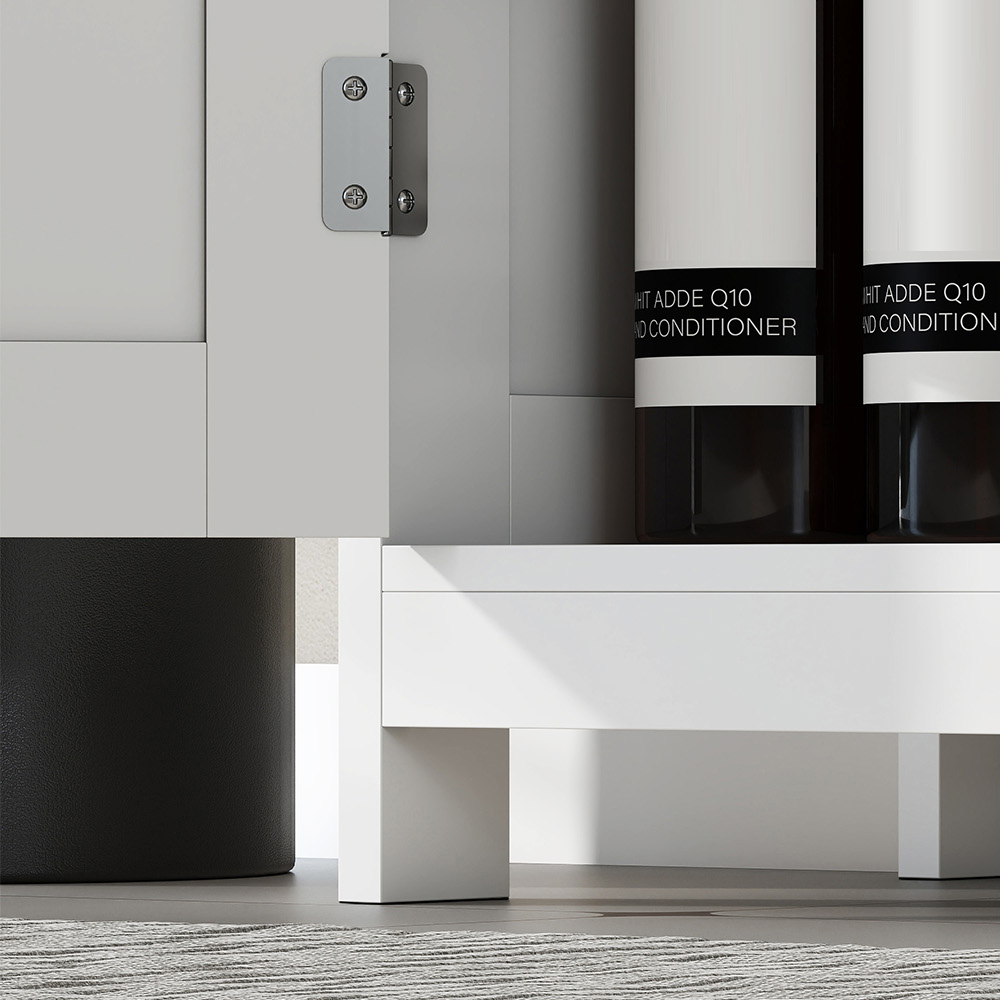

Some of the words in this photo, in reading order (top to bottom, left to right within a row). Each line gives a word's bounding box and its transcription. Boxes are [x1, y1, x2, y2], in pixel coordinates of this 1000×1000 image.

[653, 289, 704, 308] ADDE
[710, 288, 752, 310] Q10
[883, 283, 937, 303] ADDE
[943, 282, 986, 305] Q10
[649, 317, 797, 338] CONDITIONER
